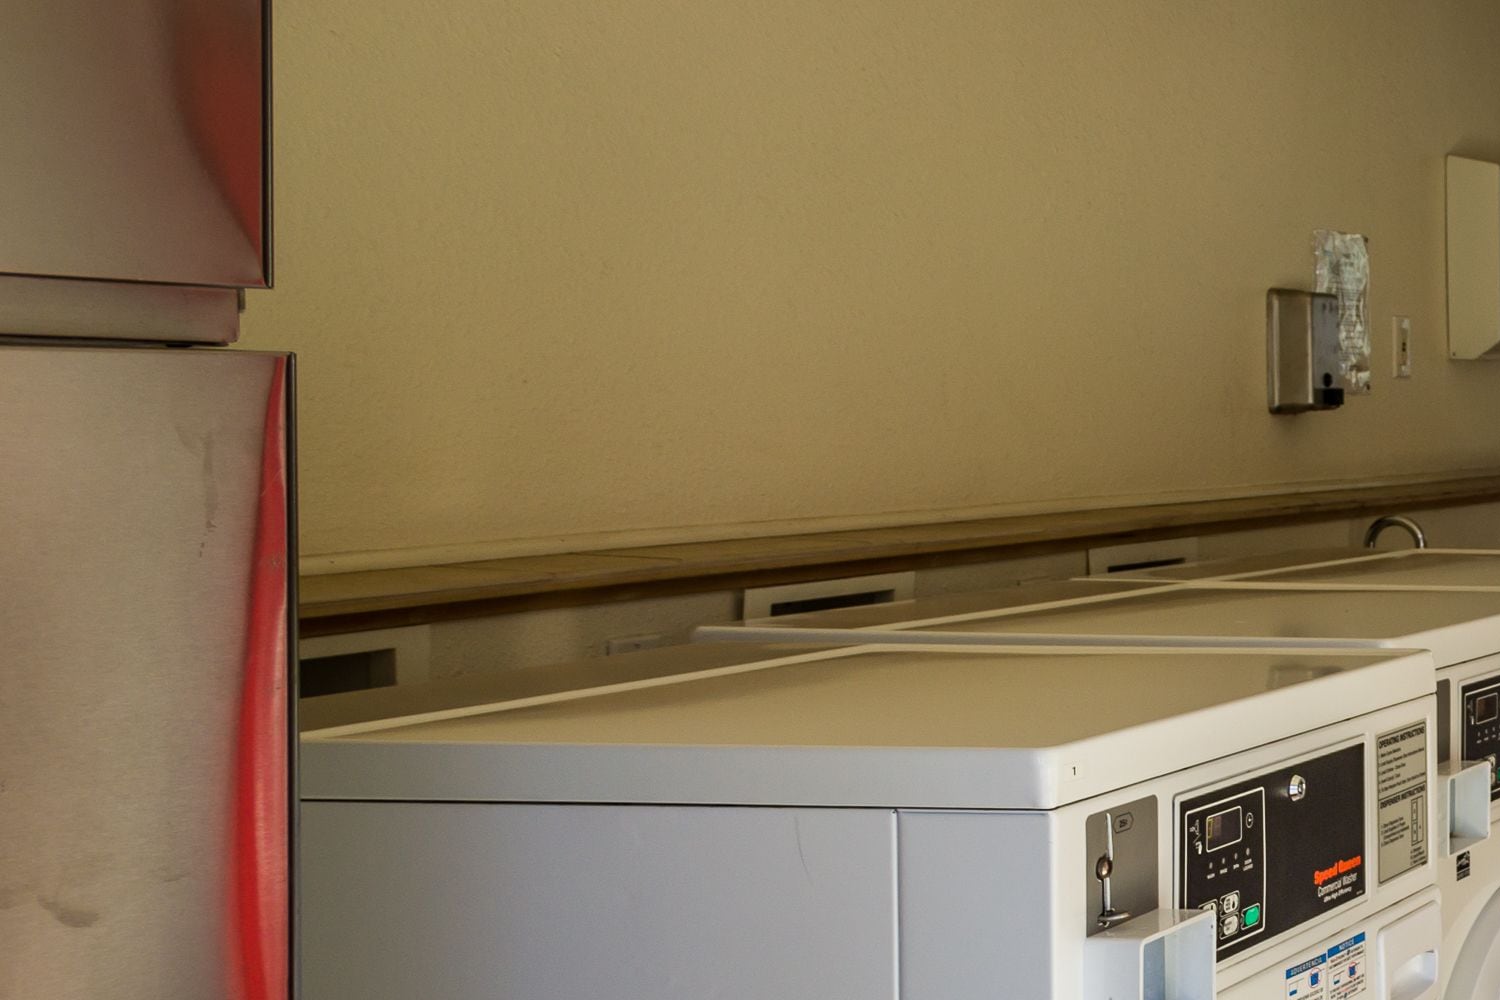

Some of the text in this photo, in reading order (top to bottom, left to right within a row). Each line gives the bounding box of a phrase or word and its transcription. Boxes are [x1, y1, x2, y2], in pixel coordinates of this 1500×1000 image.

[1400, 726, 1425, 741] INSTRUCTIONS
[1072, 766, 1076, 776] 1
[1314, 855, 1362, 885] Speed Queen
